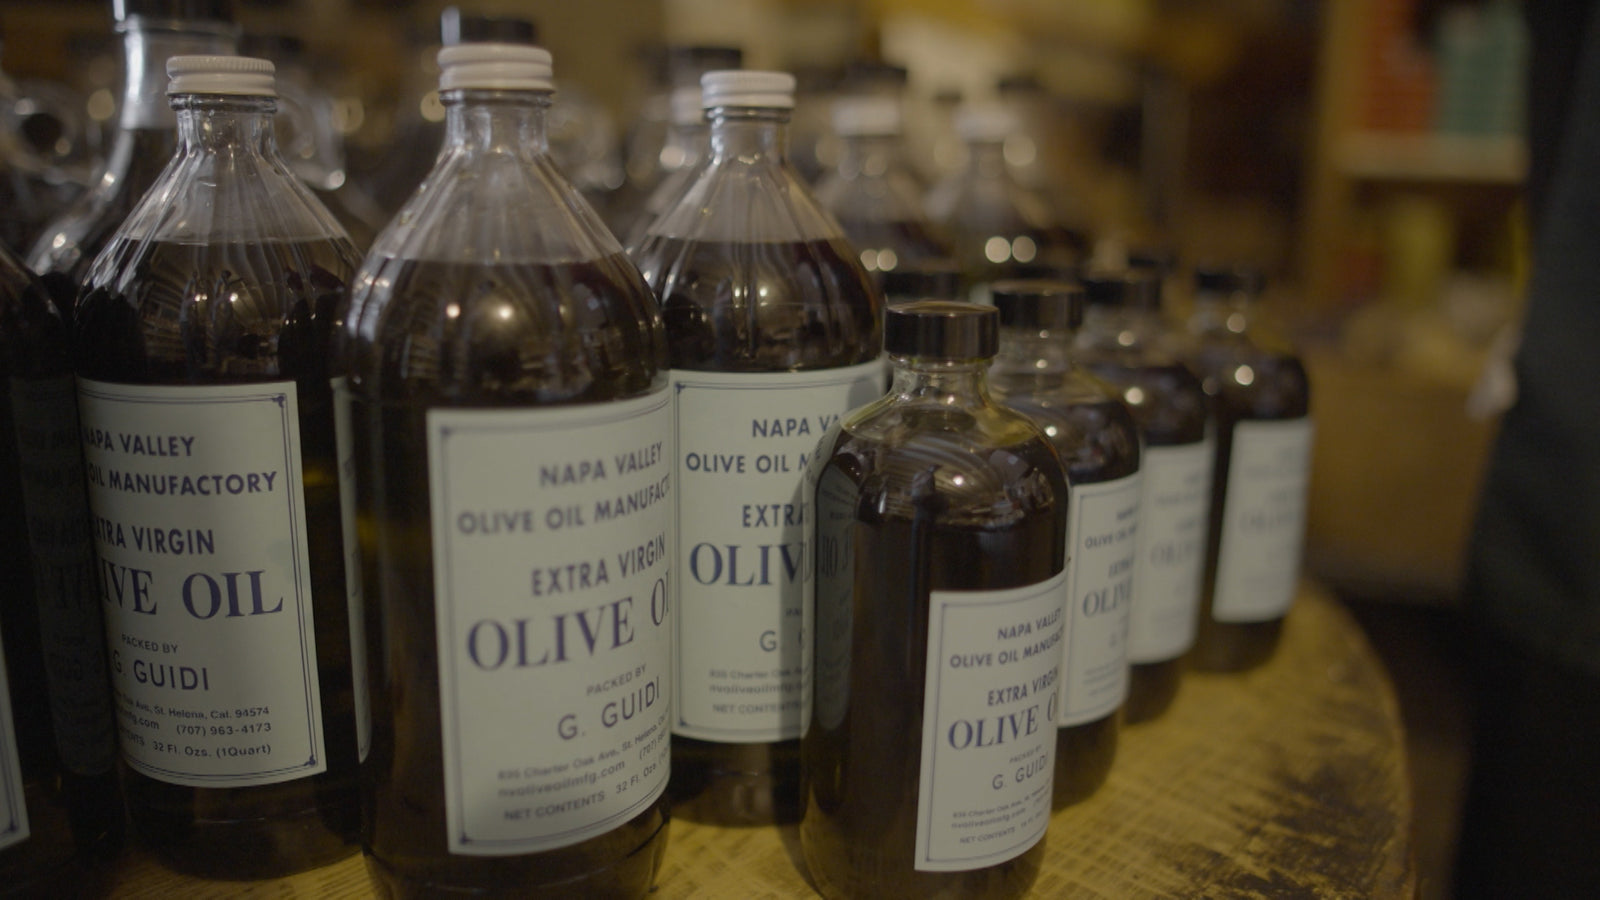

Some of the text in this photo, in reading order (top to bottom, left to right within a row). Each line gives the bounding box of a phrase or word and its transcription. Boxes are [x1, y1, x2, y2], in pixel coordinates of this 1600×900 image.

[753, 418, 811, 438] NAPA
[119, 433, 195, 457] VALLEY
[539, 441, 662, 488] NAPA VALLEY
[686, 453, 746, 473] OLIVE
[756, 454, 790, 474] OIL
[109, 470, 277, 496] MANUFACTORY
[457, 510, 535, 535] OLIVE
[545, 506, 585, 531] OIL
[132, 524, 215, 555] VIRGIN
[531, 532, 666, 597] EXTRA VIRGIN
[689, 542, 803, 587] OLIV
[182, 570, 283, 620] OIL
[1083, 575, 1132, 618] OLIV
[121, 633, 179, 653] PACKED BY
[467, 596, 634, 671] OLIVE
[997, 622, 1032, 641] NAPA
[950, 653, 993, 669] OLIVE
[998, 651, 1018, 665] OIL
[133, 659, 209, 691] GUIDI
[585, 663, 647, 696] PACKED BY
[558, 676, 660, 740] G. GUIDI
[987, 684, 1028, 706] EXTRA
[235, 707, 269, 719] 94574
[948, 705, 1039, 750] OLIVE
[176, 722, 271, 737] (707) 963-4173
[153, 740, 165, 753] 32
[216, 743, 271, 759] (1Quart)
[504, 806, 531, 821] NET
[535, 791, 605, 817] CONTENTS
[615, 780, 628, 794] 32
[959, 834, 976, 844] NET
